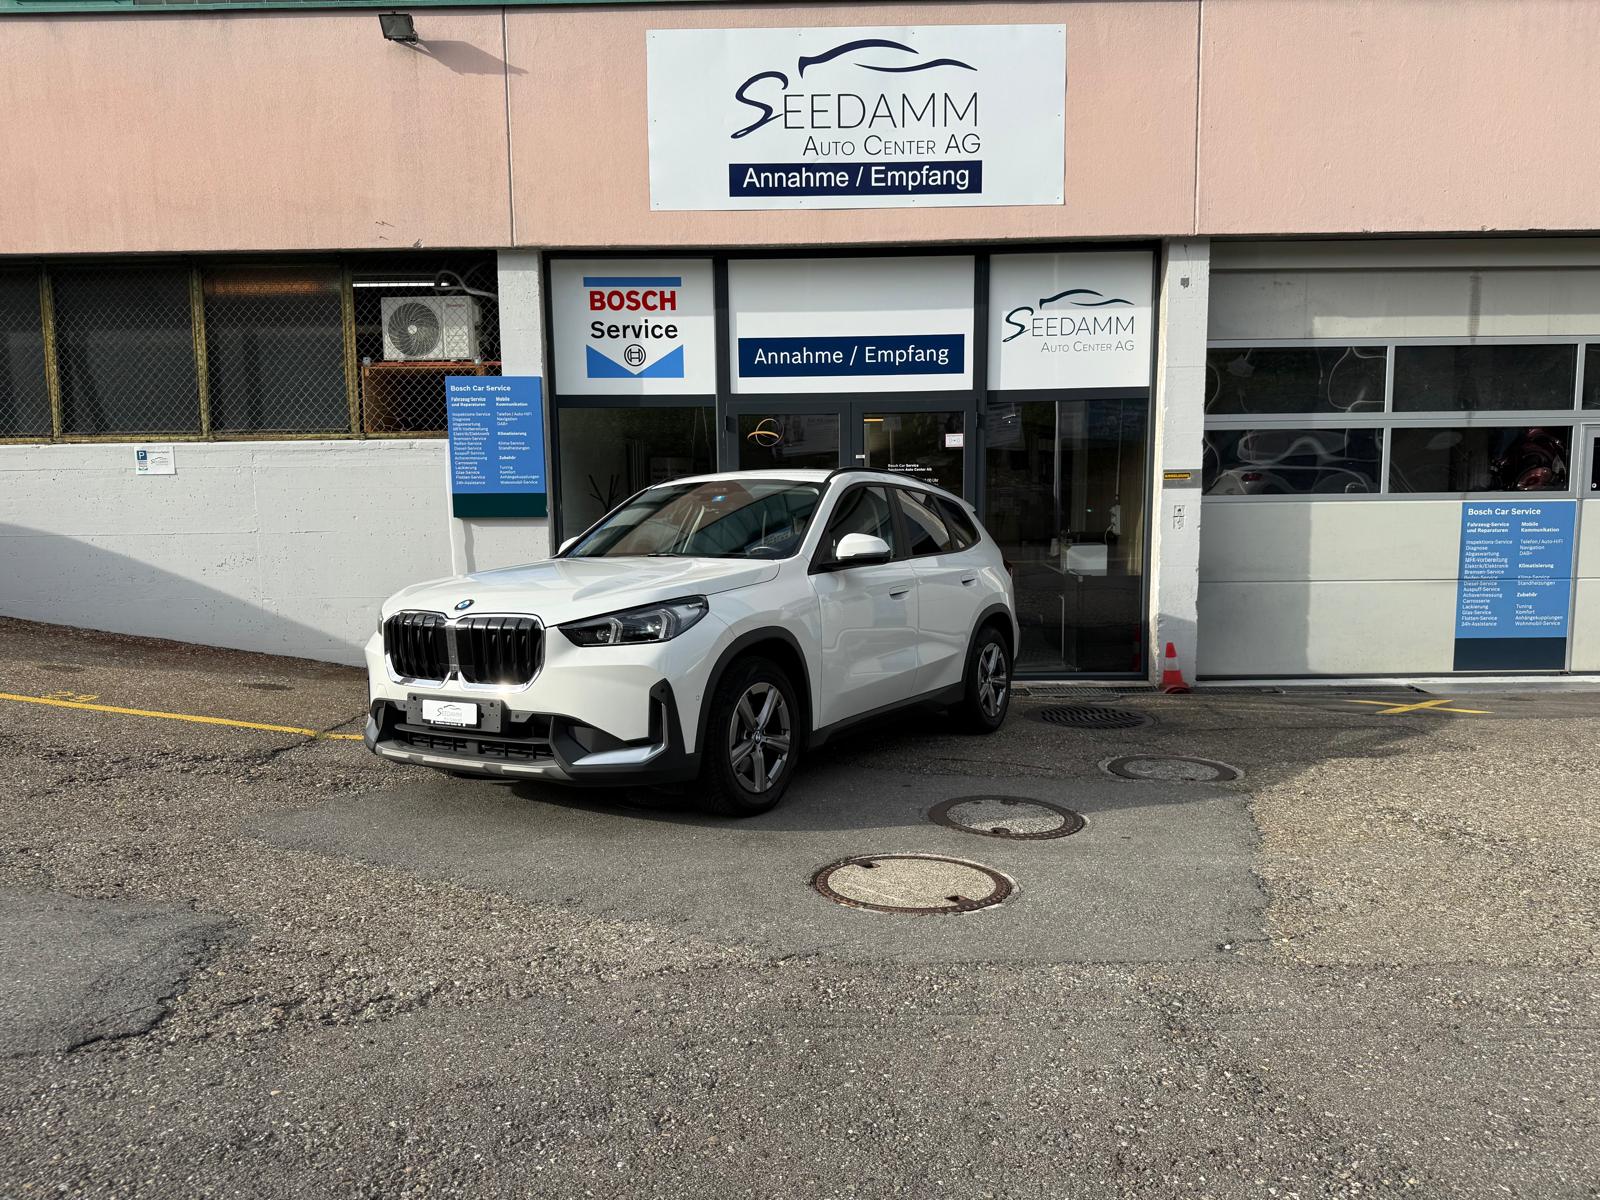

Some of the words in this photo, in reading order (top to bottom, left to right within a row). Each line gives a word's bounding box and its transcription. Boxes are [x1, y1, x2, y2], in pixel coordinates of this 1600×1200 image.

[945, 133, 981, 154] AG
[743, 167, 849, 188] Annahme
[856, 166, 864, 187] /
[871, 165, 969, 189] Empfang
[589, 290, 677, 311] BOSCH
[590, 319, 678, 339] Service
[754, 347, 843, 365] Annahme
[850, 346, 858, 366] /
[865, 345, 949, 365] Empfang
[1115, 340, 1134, 351] AG
[1468, 508, 1493, 516] Bosch
[1511, 507, 1541, 515] Service
